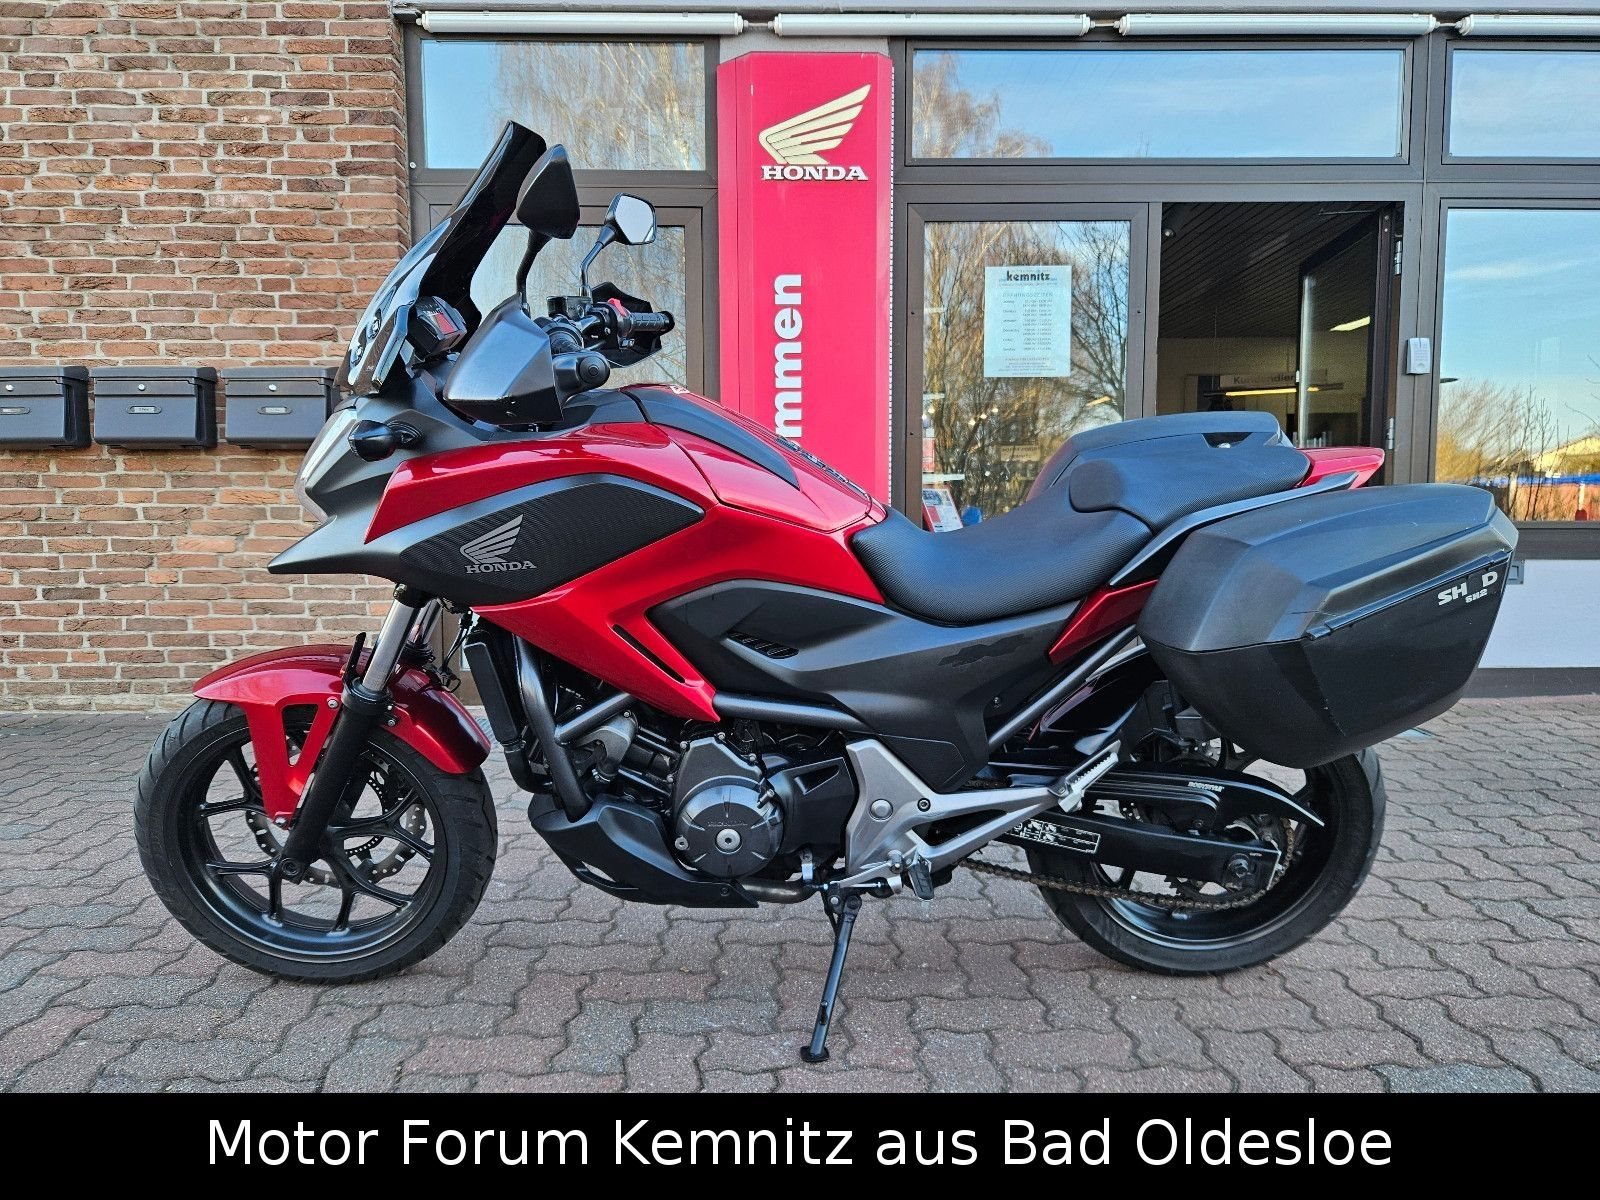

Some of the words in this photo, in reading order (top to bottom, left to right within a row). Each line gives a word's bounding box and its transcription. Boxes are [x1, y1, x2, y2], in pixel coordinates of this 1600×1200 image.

[761, 165, 868, 181] HONDA
[1006, 270, 1050, 281] kemnitz
[774, 274, 802, 447] mmen
[464, 560, 537, 574] HONDA
[1437, 571, 1498, 606] SHD
